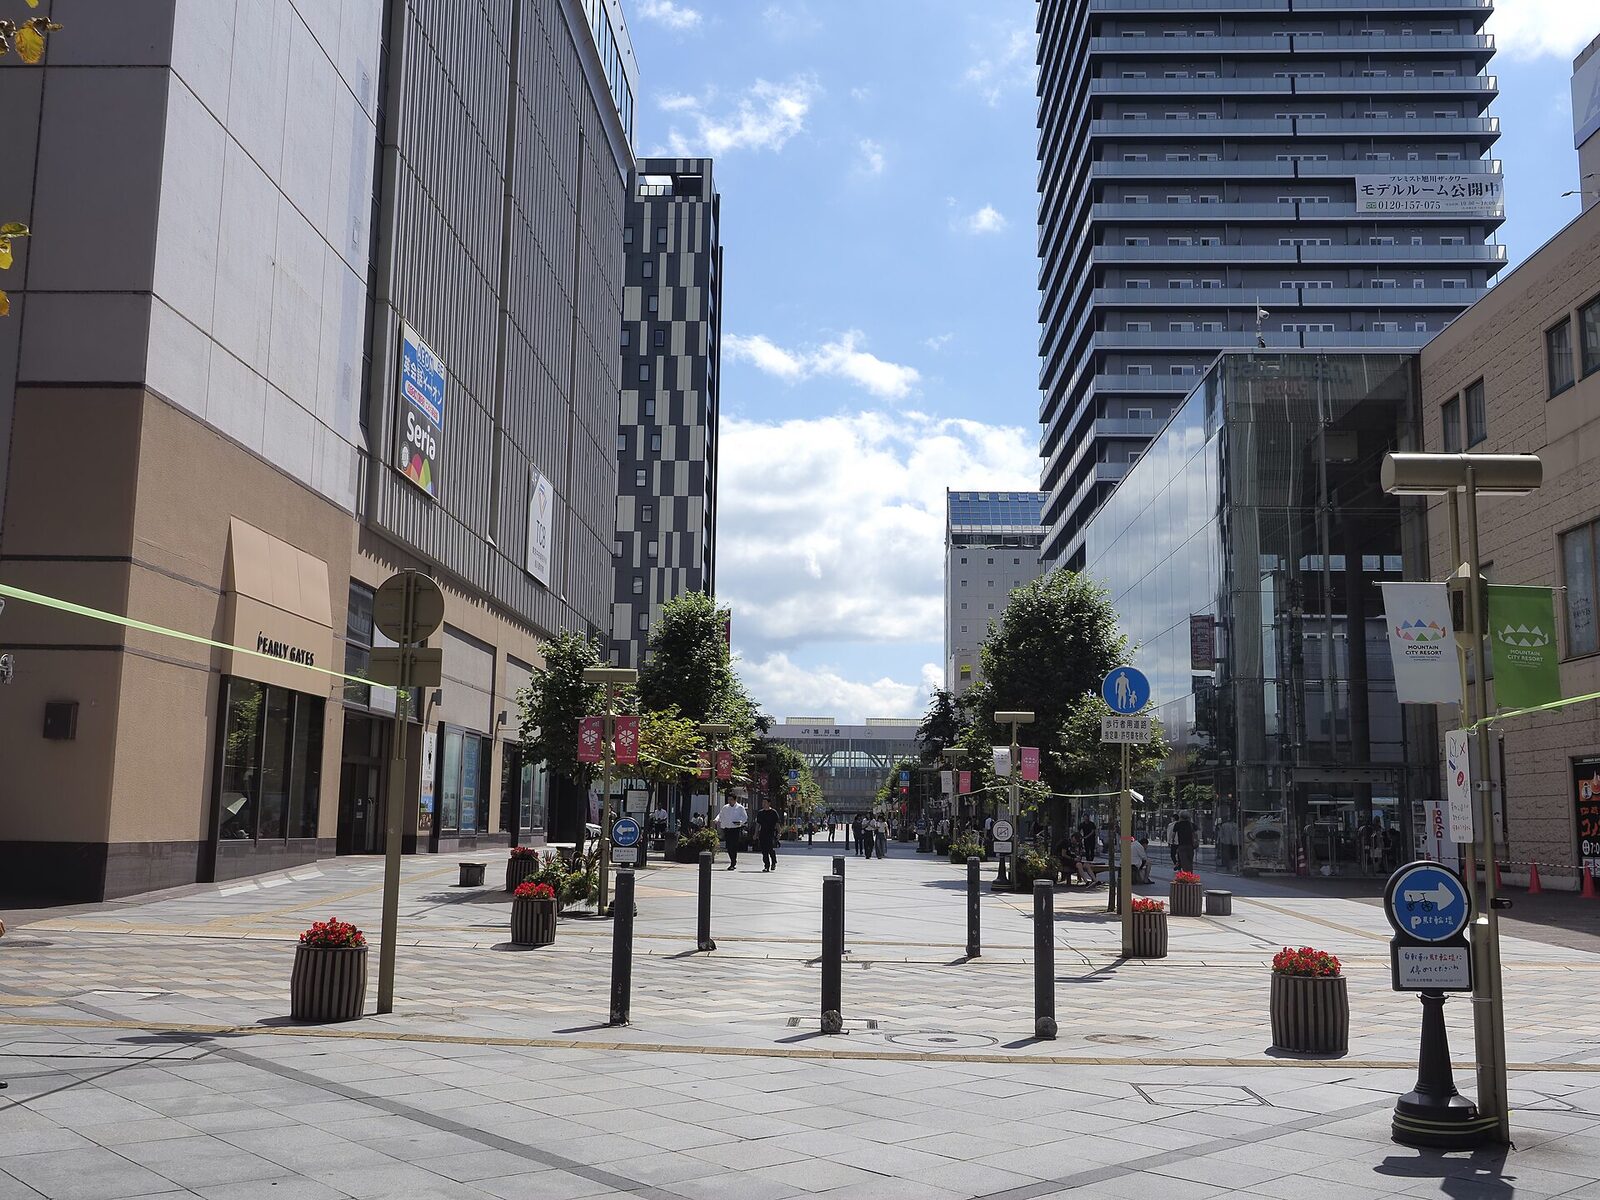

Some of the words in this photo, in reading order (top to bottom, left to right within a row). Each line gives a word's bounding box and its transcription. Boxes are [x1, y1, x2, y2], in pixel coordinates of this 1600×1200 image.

[1390, 175, 1468, 183] プレミスト旭川ザ・タワー
[1361, 182, 1500, 197] モデルルーム公開中
[1378, 201, 1441, 210] 0120-157-075
[406, 411, 436, 461] Seria
[256, 630, 289, 660] PEARLY
[289, 646, 315, 667] GATES
[1106, 719, 1147, 730] 歩行者用道路
[1435, 809, 1444, 839] DyDo
